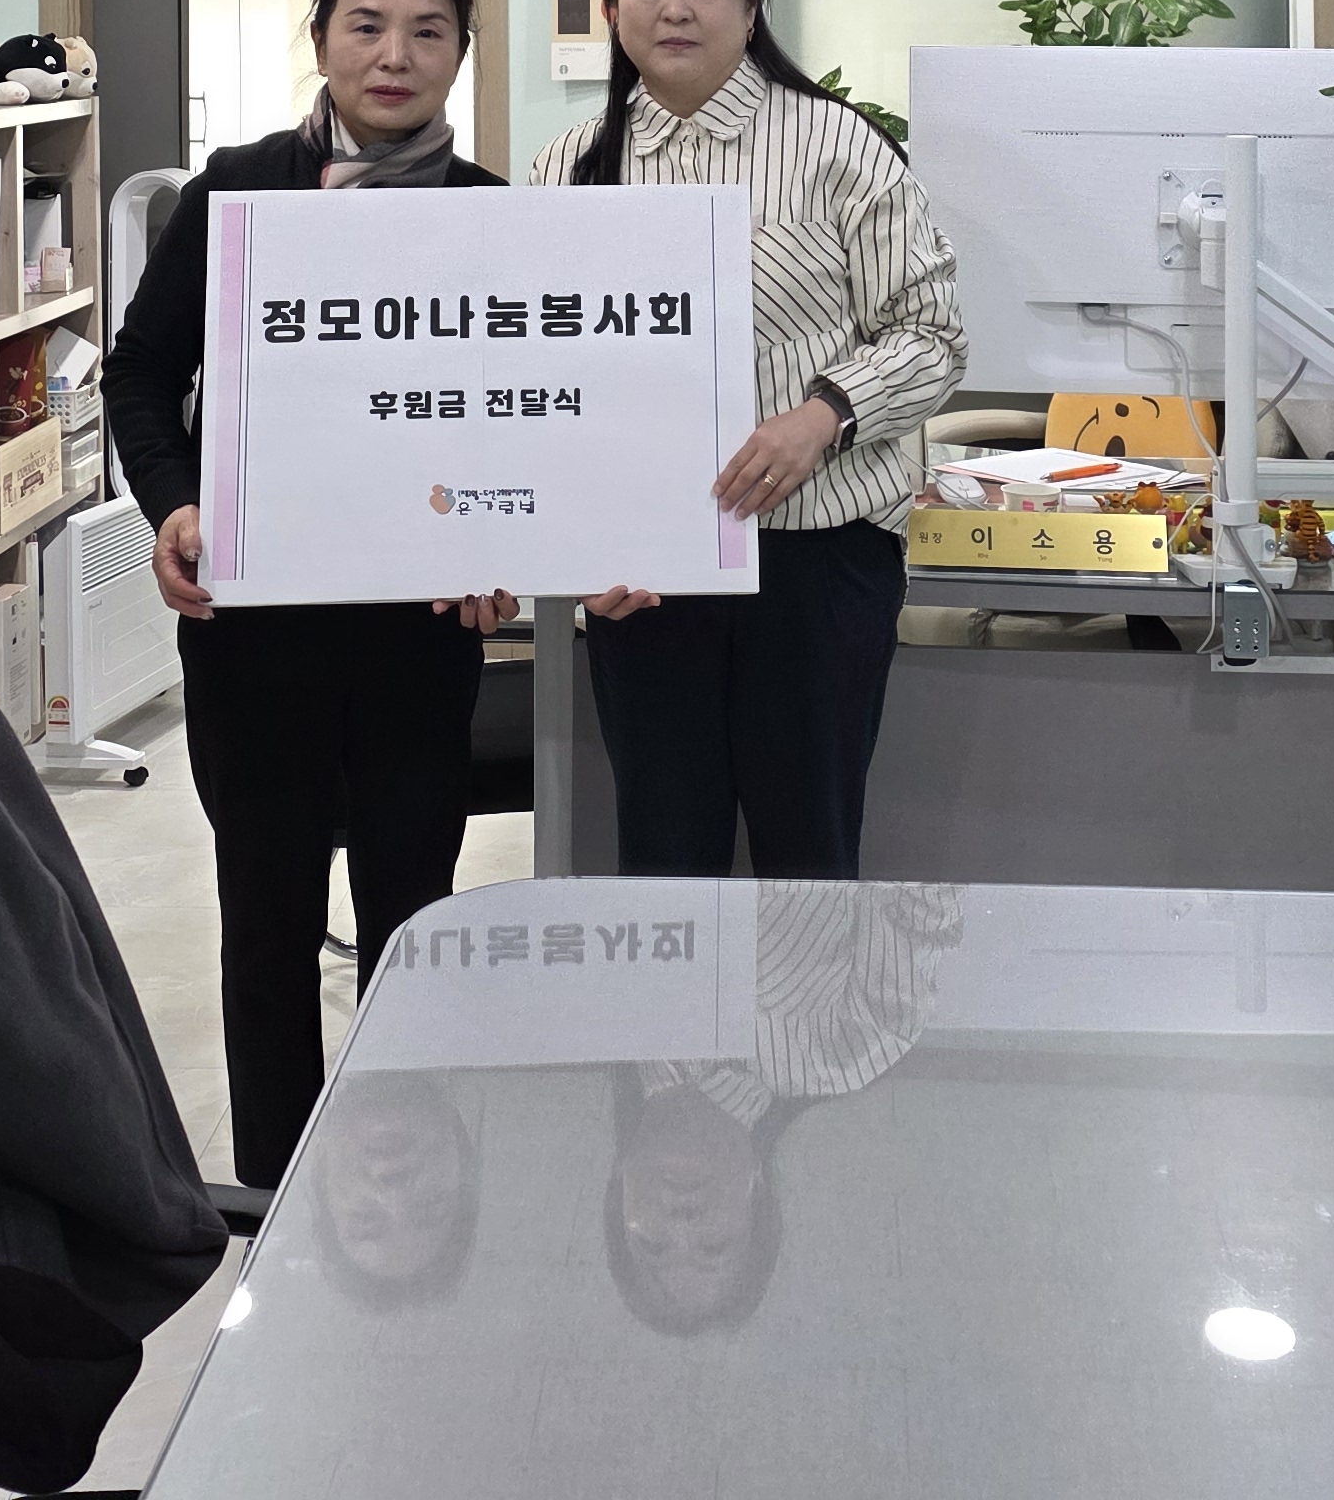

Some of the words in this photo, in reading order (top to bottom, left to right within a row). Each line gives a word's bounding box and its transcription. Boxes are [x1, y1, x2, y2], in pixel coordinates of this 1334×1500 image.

[262, 291, 692, 344] 정모아나눔봉사회
[369, 390, 467, 421] 후원금
[485, 387, 582, 418] 전달식
[918, 531, 943, 544] 원장
[970, 526, 993, 551] 이
[1031, 528, 1055, 549] 소
[1092, 529, 1116, 555] 용
